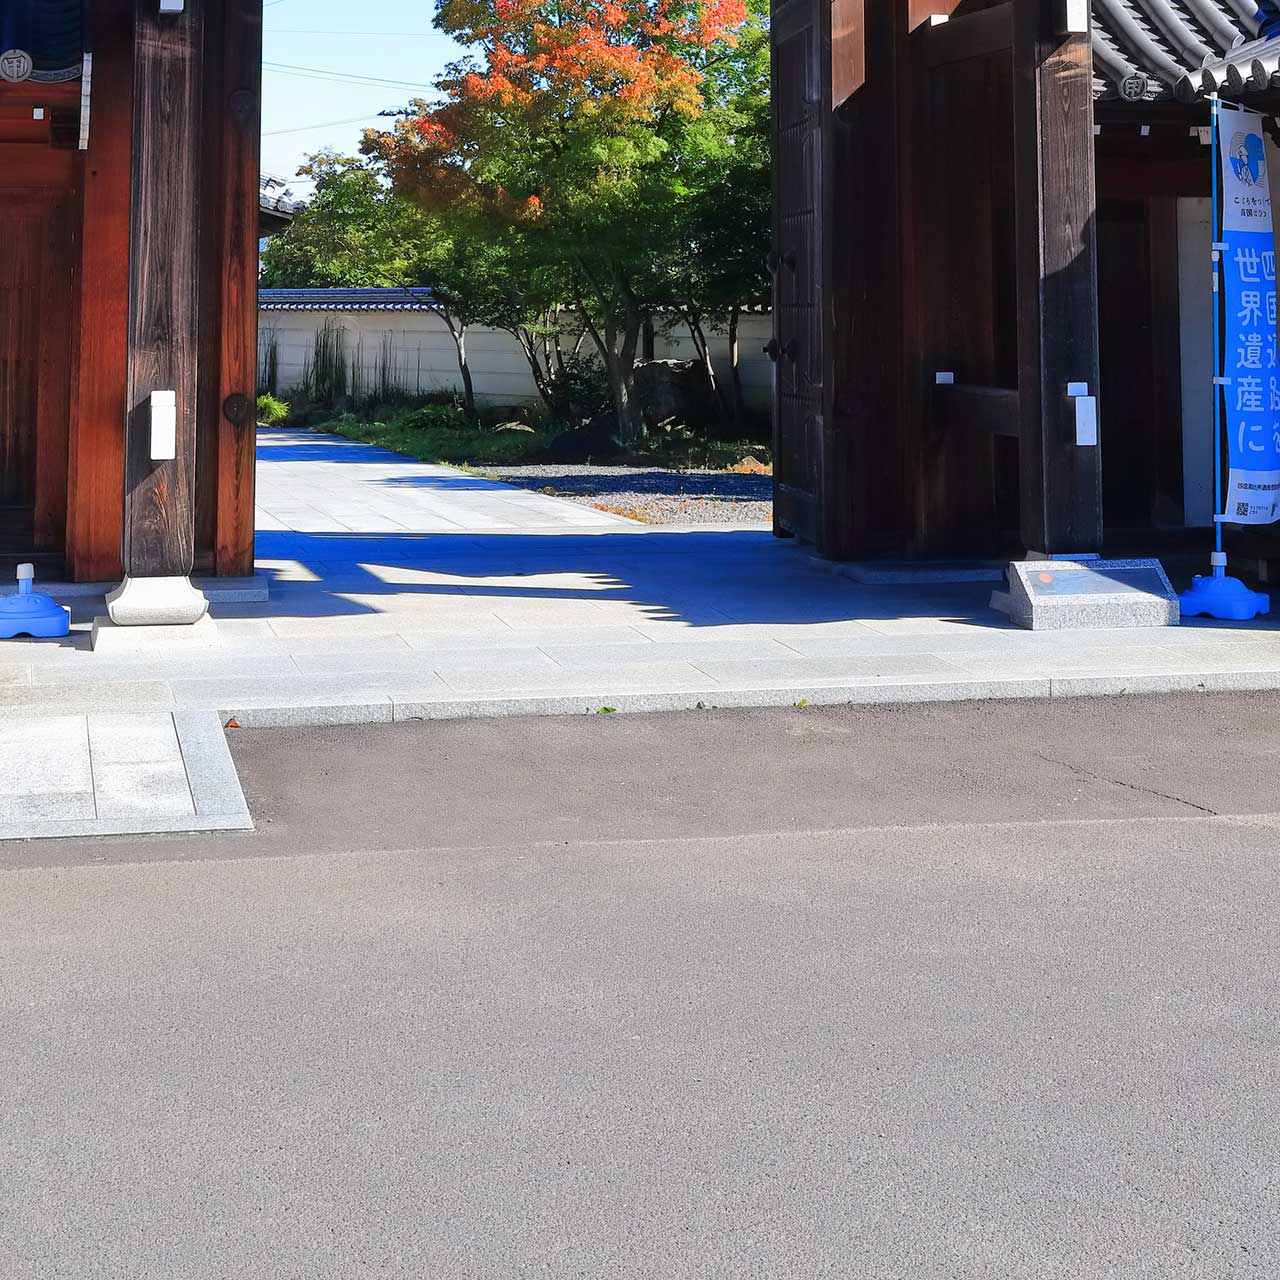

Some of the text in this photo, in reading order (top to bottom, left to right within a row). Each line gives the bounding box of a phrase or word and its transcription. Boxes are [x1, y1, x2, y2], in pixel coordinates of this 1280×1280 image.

[1234, 248, 1264, 453] 世界遺産に
